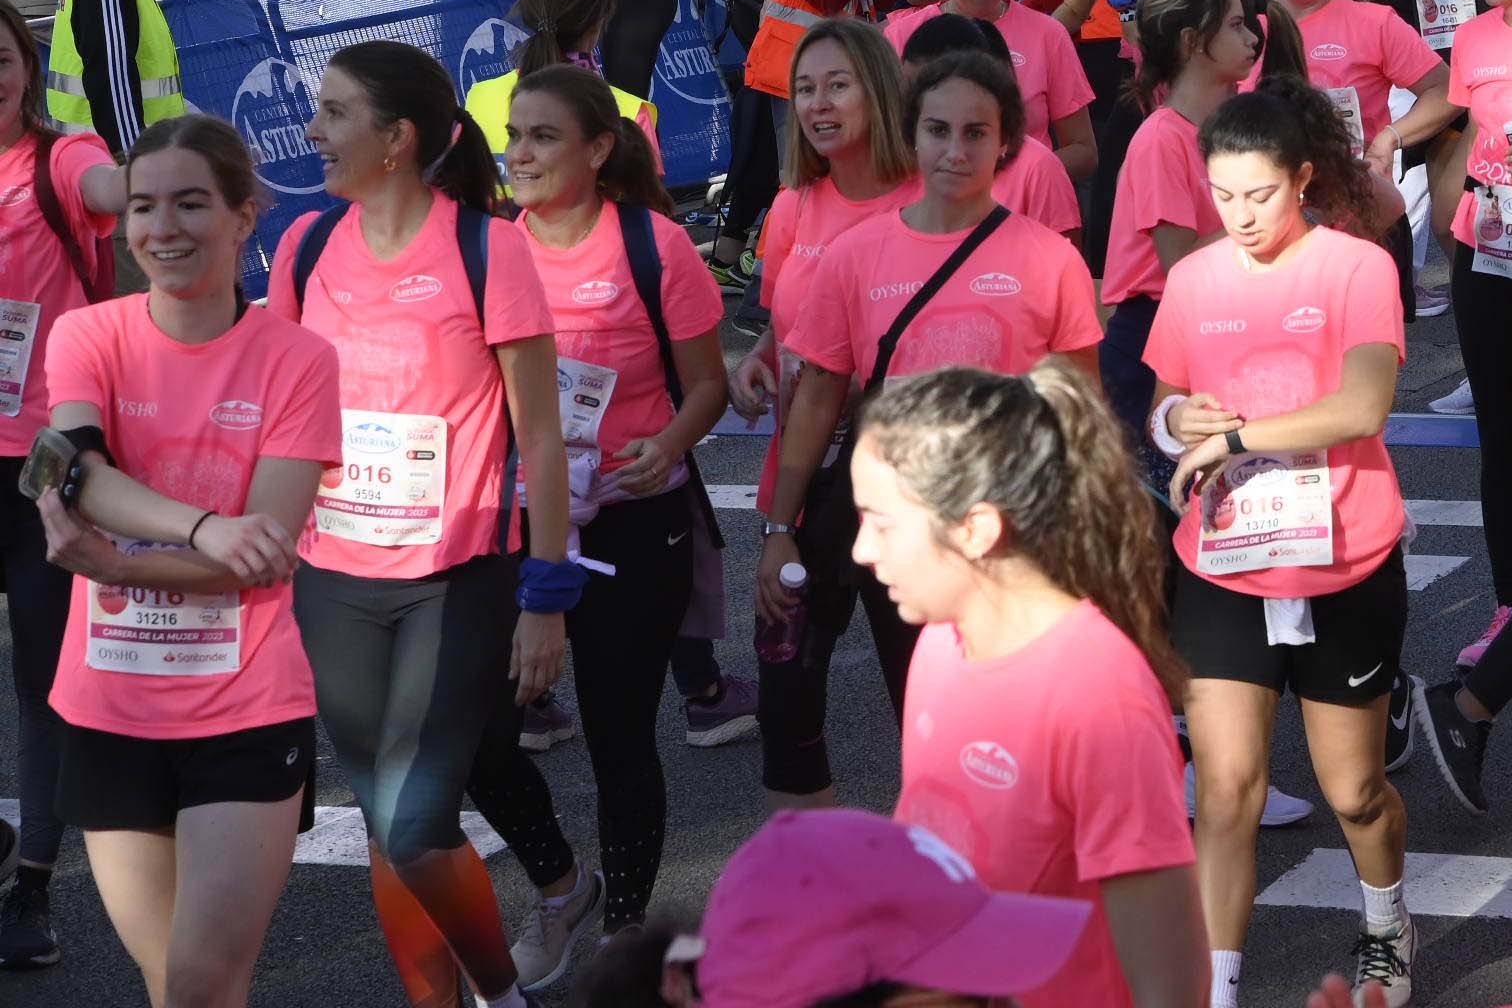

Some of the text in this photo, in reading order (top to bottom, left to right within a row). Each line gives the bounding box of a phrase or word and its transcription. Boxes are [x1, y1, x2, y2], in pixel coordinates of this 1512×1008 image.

[1440, 3, 1458, 15] 016
[660, 42, 716, 81] ASTUR
[1199, 319, 1248, 335] OYSHO
[117, 397, 159, 417] YSHO
[347, 463, 392, 484] 016
[354, 488, 382, 501] 9594
[324, 499, 354, 512] CARRERA
[354, 502, 365, 512] DE
[365, 505, 377, 513] LA
[377, 507, 406, 517] MUJER
[1240, 496, 1284, 515] 016
[1214, 538, 1248, 550] CARRERA
[1249, 536, 1261, 545] DE
[1261, 534, 1271, 543] LA
[1210, 552, 1248, 567] OYSHO
[136, 612, 178, 626] 31216
[102, 628, 138, 640] CARRERA
[139, 632, 150, 640] DE
[153, 632, 165, 641] LA
[166, 633, 199, 641] MUJER
[98, 647, 228, 664] OYSHO Santander
